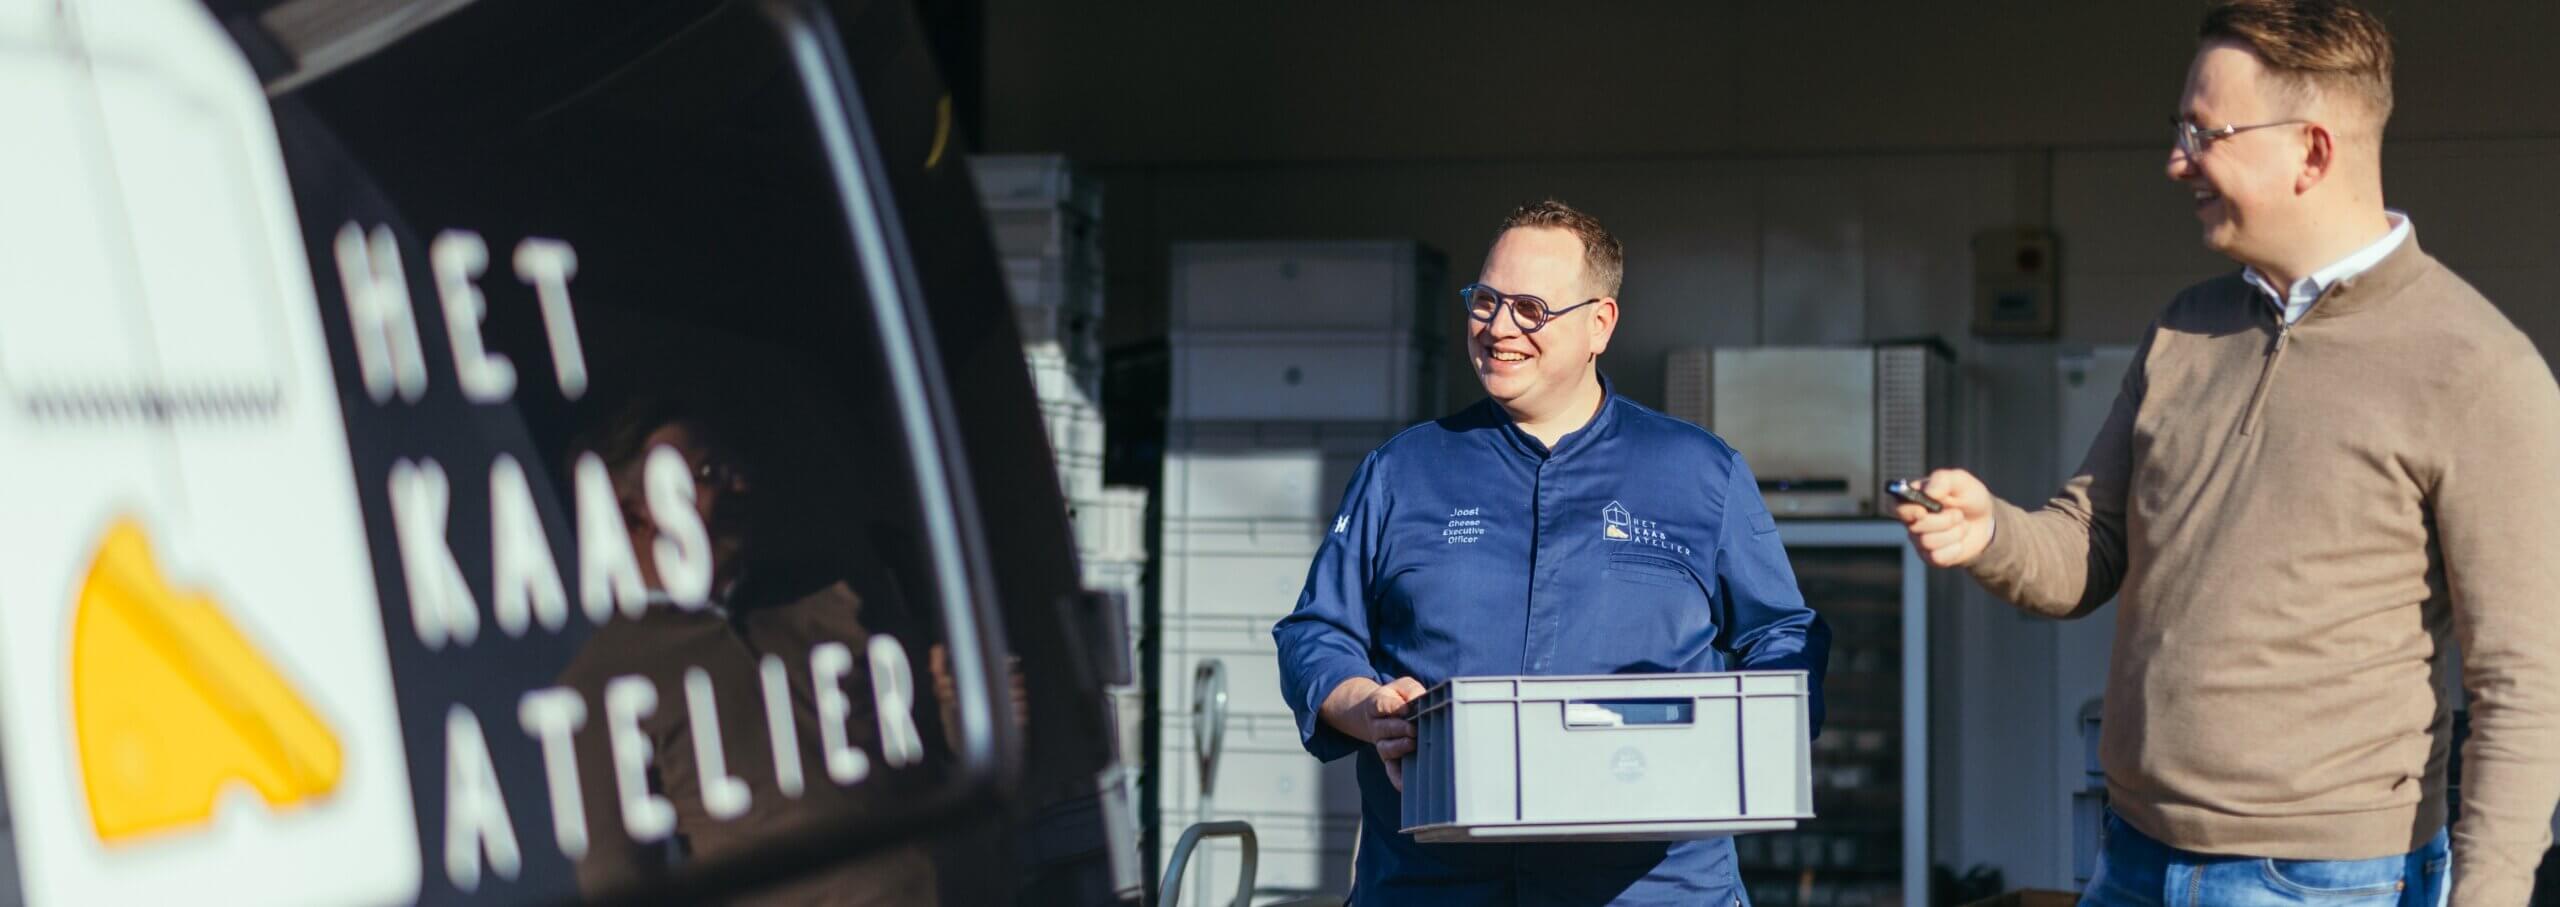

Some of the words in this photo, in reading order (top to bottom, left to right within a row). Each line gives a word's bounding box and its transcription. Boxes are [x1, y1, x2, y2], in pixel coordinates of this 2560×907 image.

[335, 222, 588, 403] HET
[1450, 508, 1479, 517] Joost
[1633, 518, 1656, 529] HET
[1442, 528, 1485, 536] Executive
[1634, 527, 1666, 540] KAAS
[1448, 536, 1479, 544] Officer
[1634, 537, 1690, 556] ATELIER
[389, 446, 713, 648] KAAS
[445, 634, 924, 890] ATELIER
